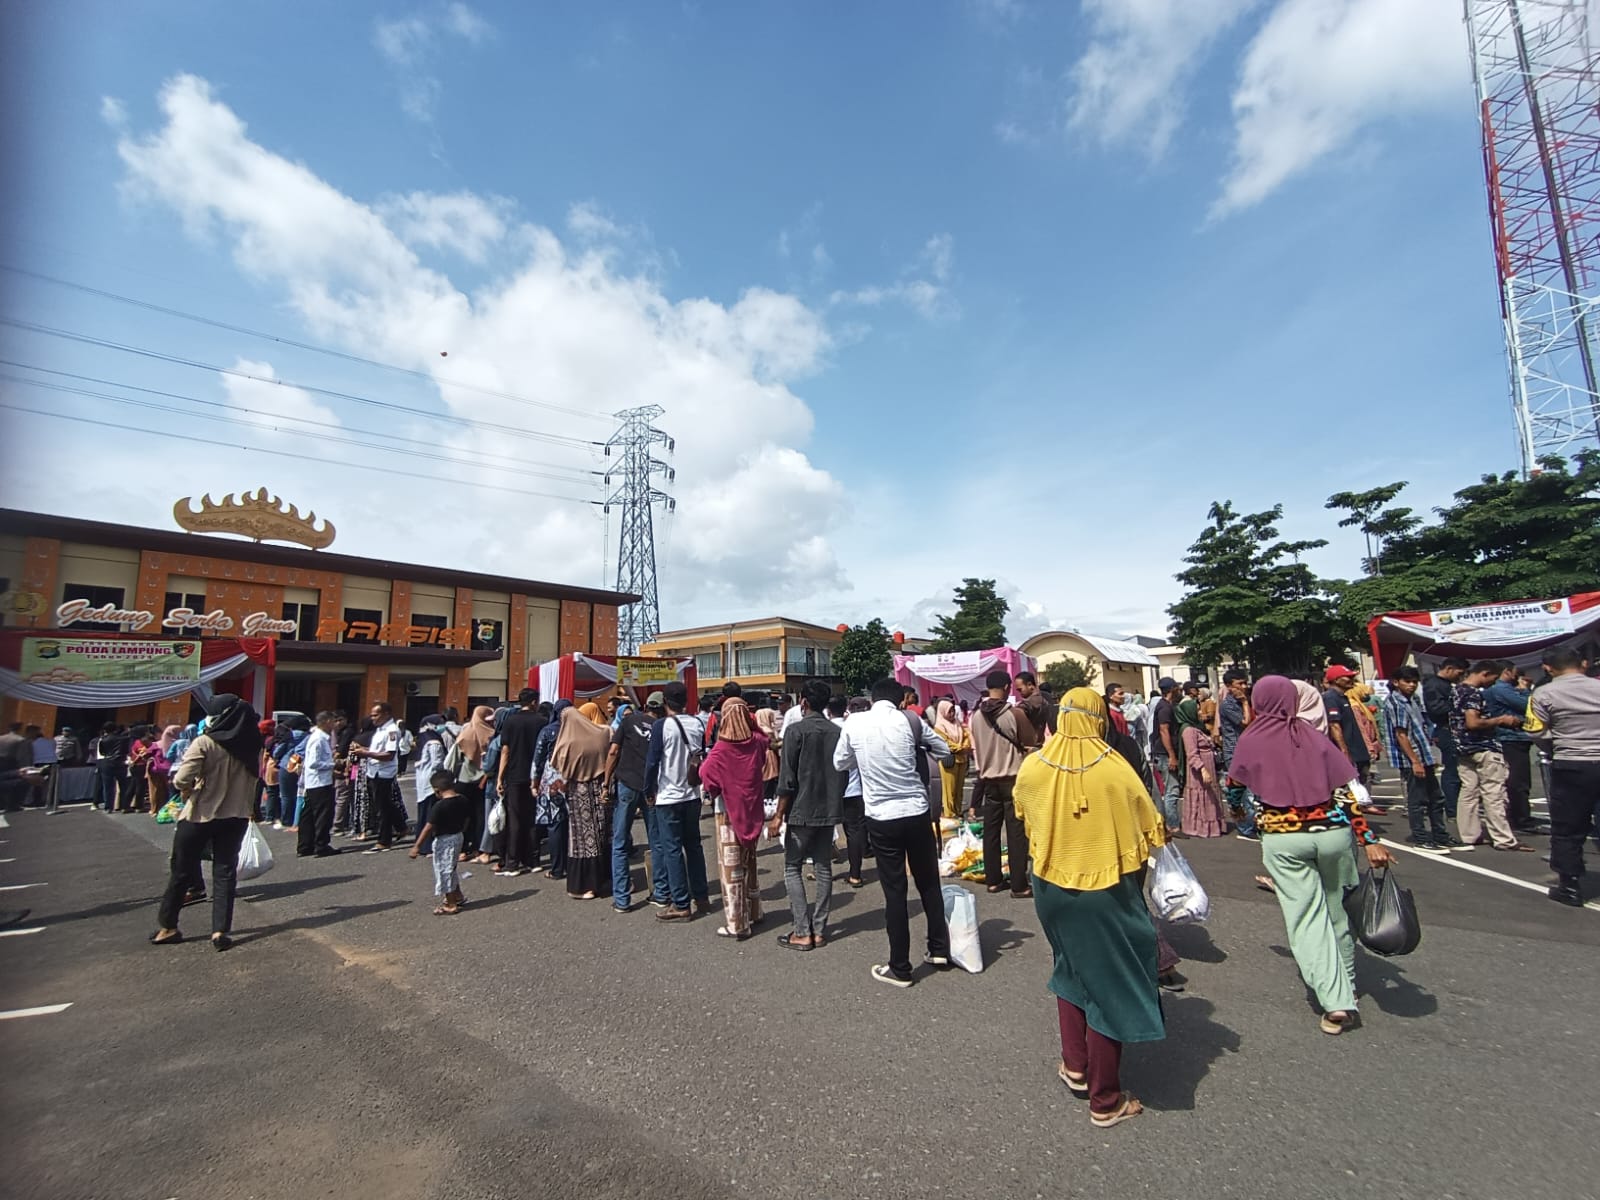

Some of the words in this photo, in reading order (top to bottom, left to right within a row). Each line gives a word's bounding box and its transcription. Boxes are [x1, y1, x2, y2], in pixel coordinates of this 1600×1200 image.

[57, 599, 153, 630] Gedung
[163, 608, 234, 631] Serba
[242, 612, 297, 635] Guna
[1456, 611, 1488, 620] POLDA
[1490, 607, 1541, 618] LAMPUNG
[315, 619, 472, 650] PRESISI
[66, 646, 109, 654] POLDA
[111, 647, 171, 655] LAMPUNG
